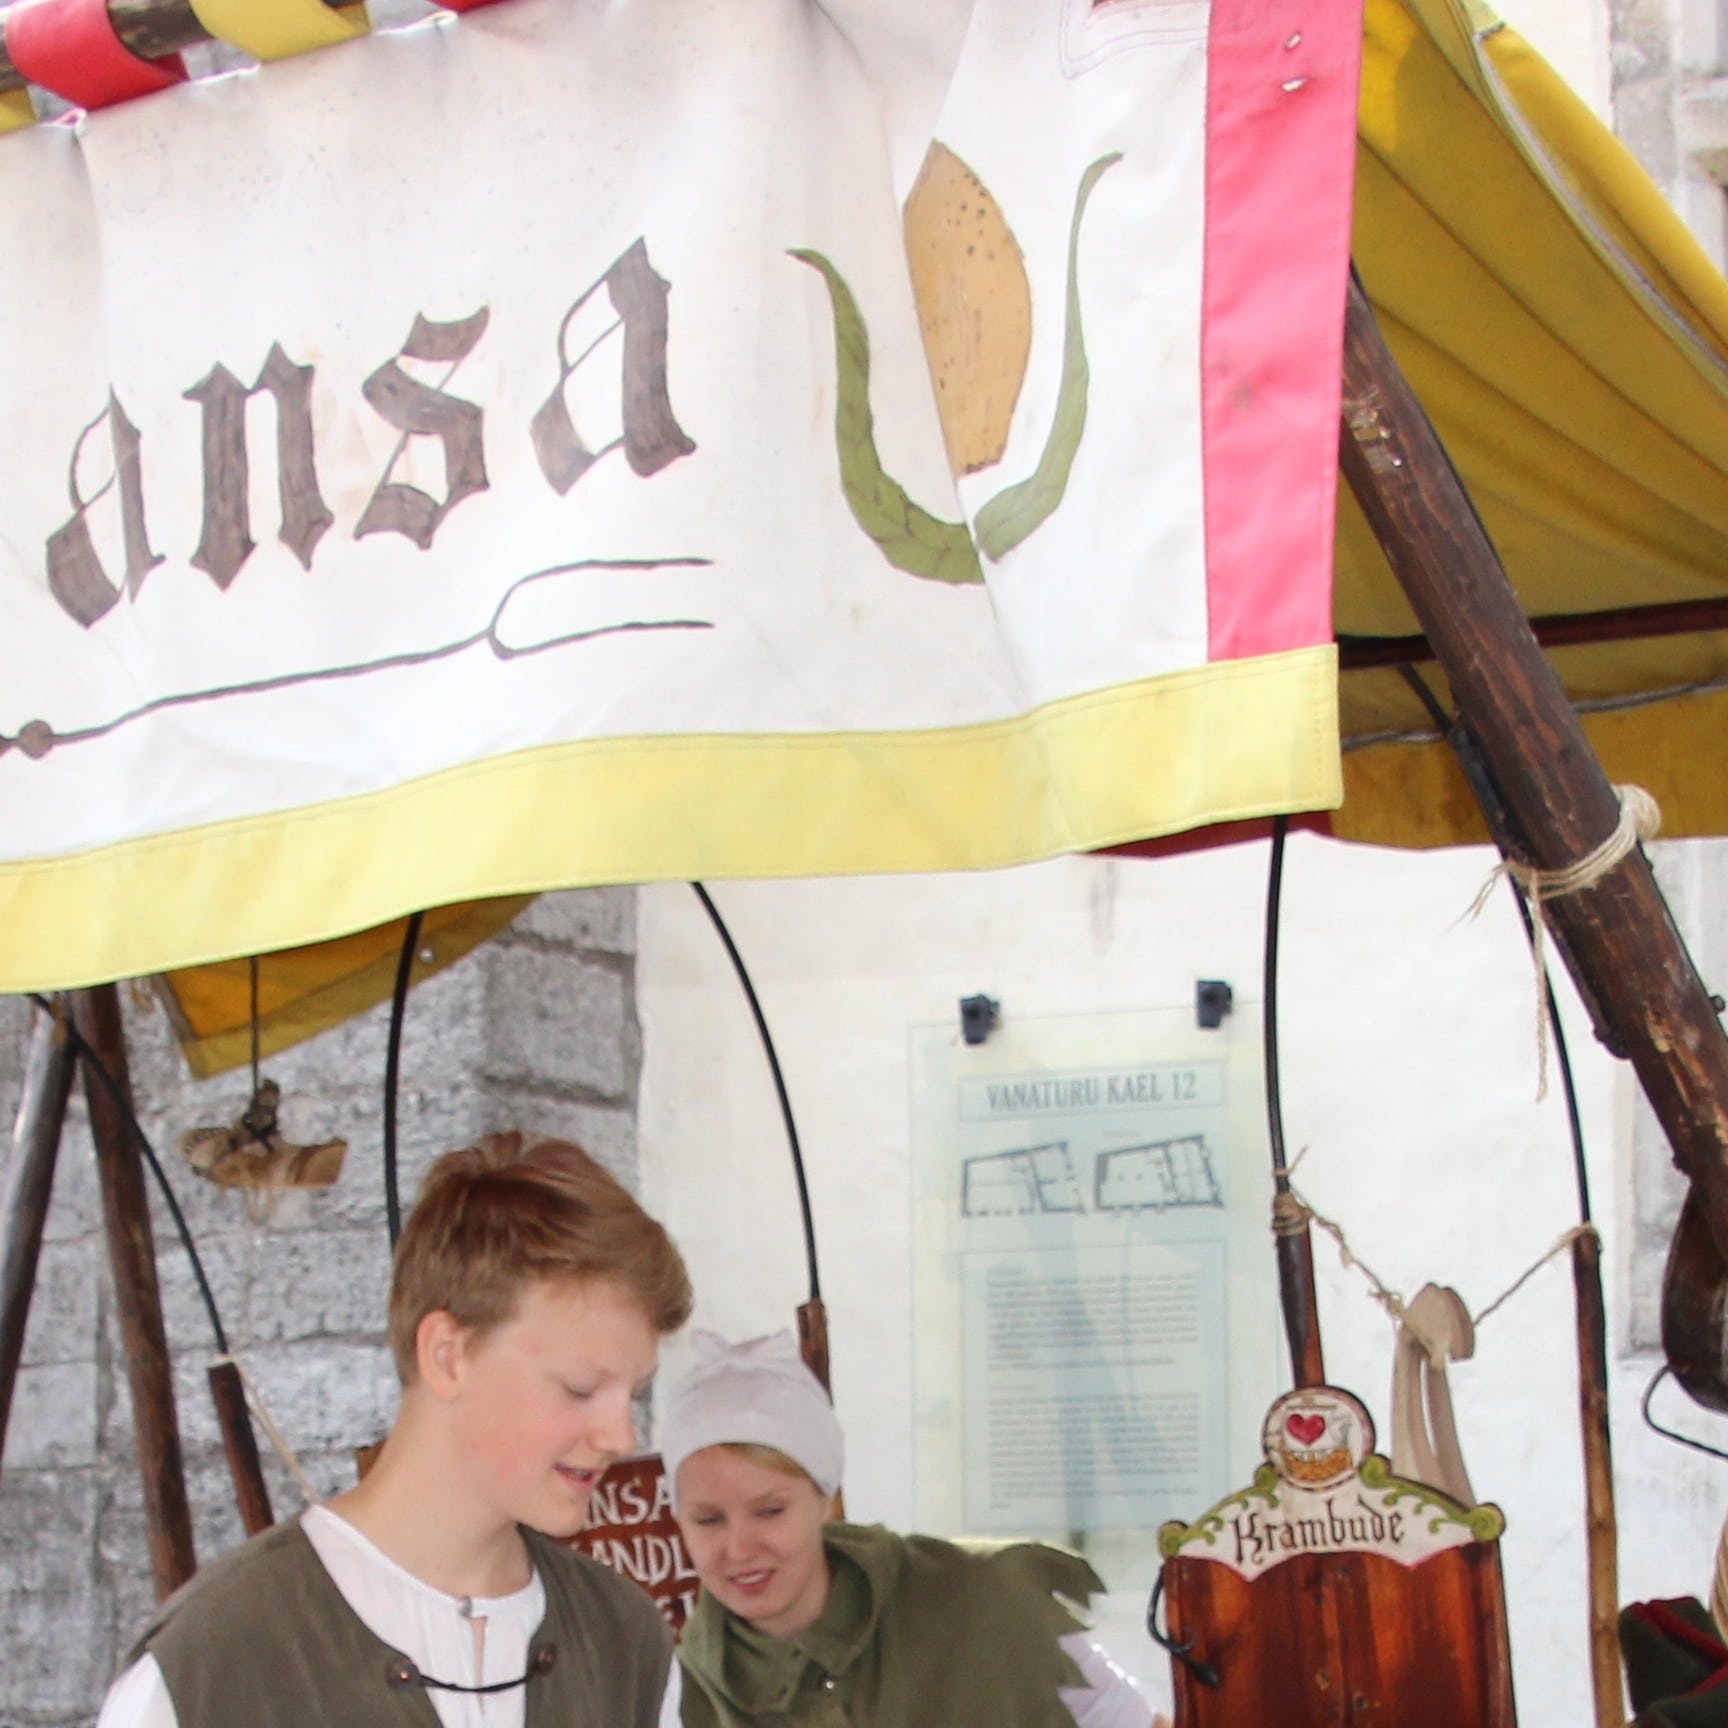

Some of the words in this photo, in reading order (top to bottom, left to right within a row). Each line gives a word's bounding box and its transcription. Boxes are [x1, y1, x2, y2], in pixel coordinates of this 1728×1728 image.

[986, 1076, 1099, 1111] VANATURU
[1107, 1073, 1163, 1105] KAEL
[1173, 1070, 1197, 1101] 12
[1230, 1493, 1405, 1565] Krambude
